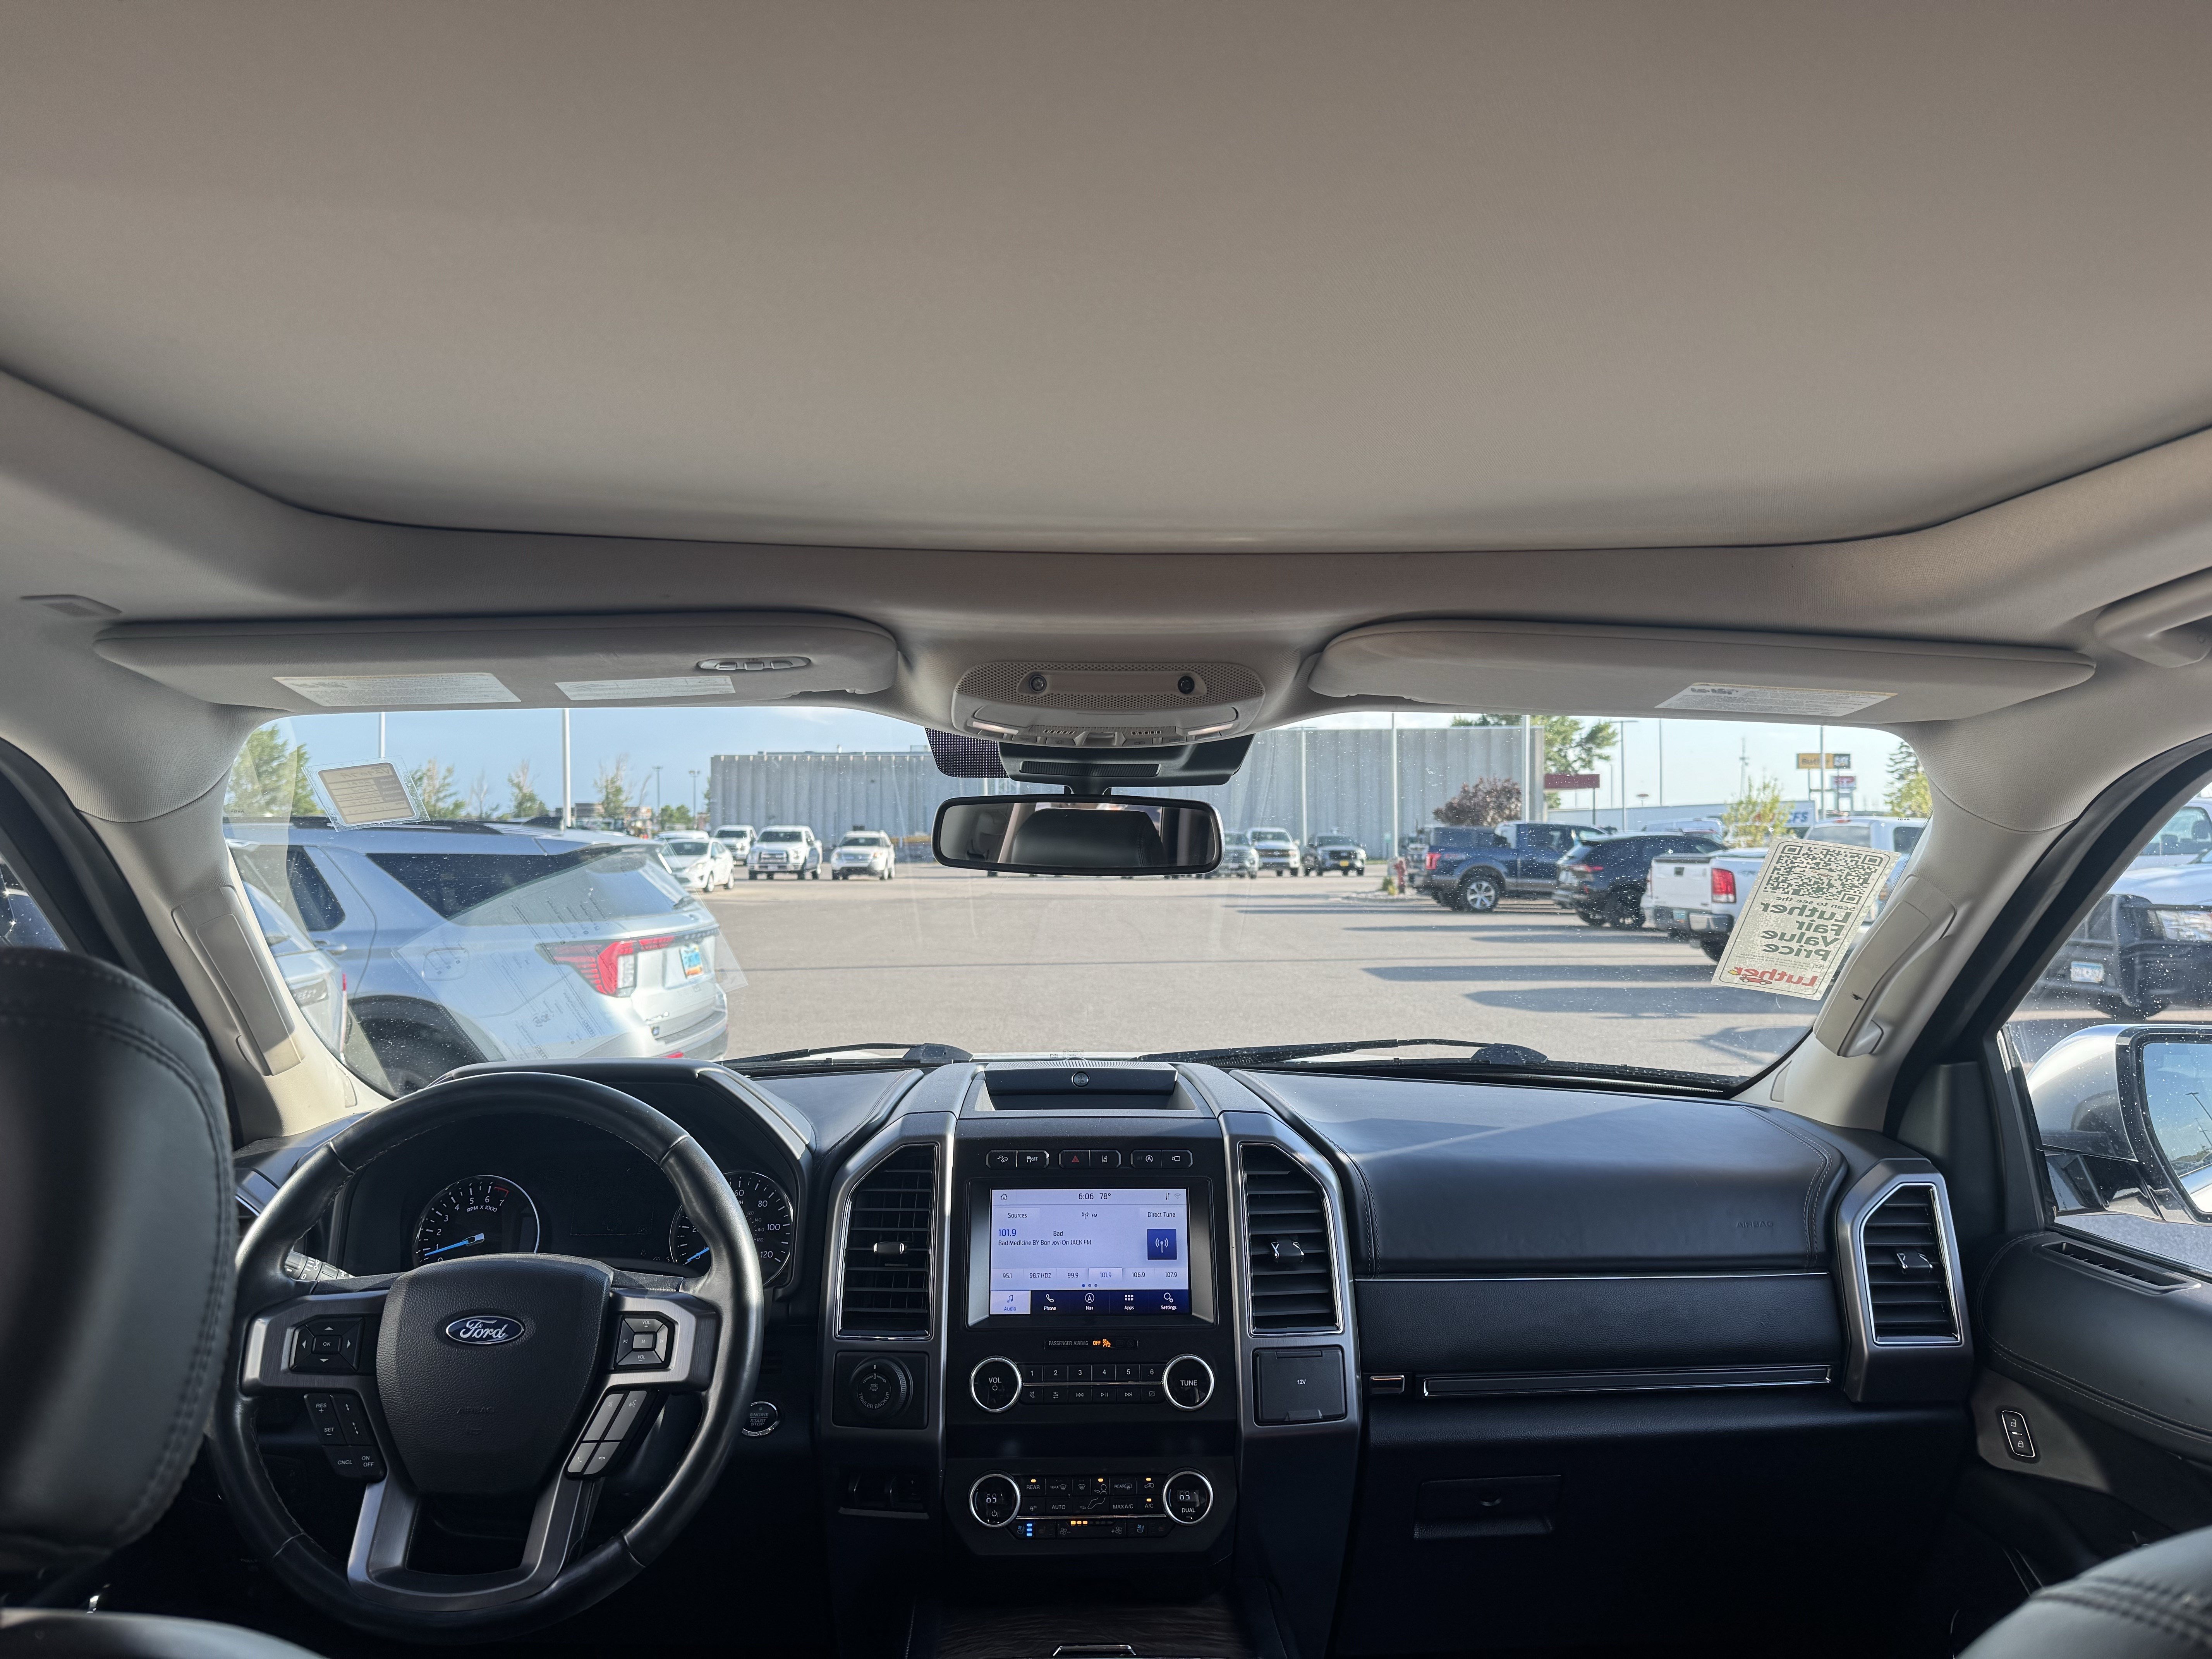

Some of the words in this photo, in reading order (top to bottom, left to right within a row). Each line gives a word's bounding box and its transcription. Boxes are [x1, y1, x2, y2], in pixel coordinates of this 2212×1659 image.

[460, 1319, 508, 1339] Ford
[859, 1392, 873, 1409] TRAILER
[874, 1392, 890, 1409] BACKUP
